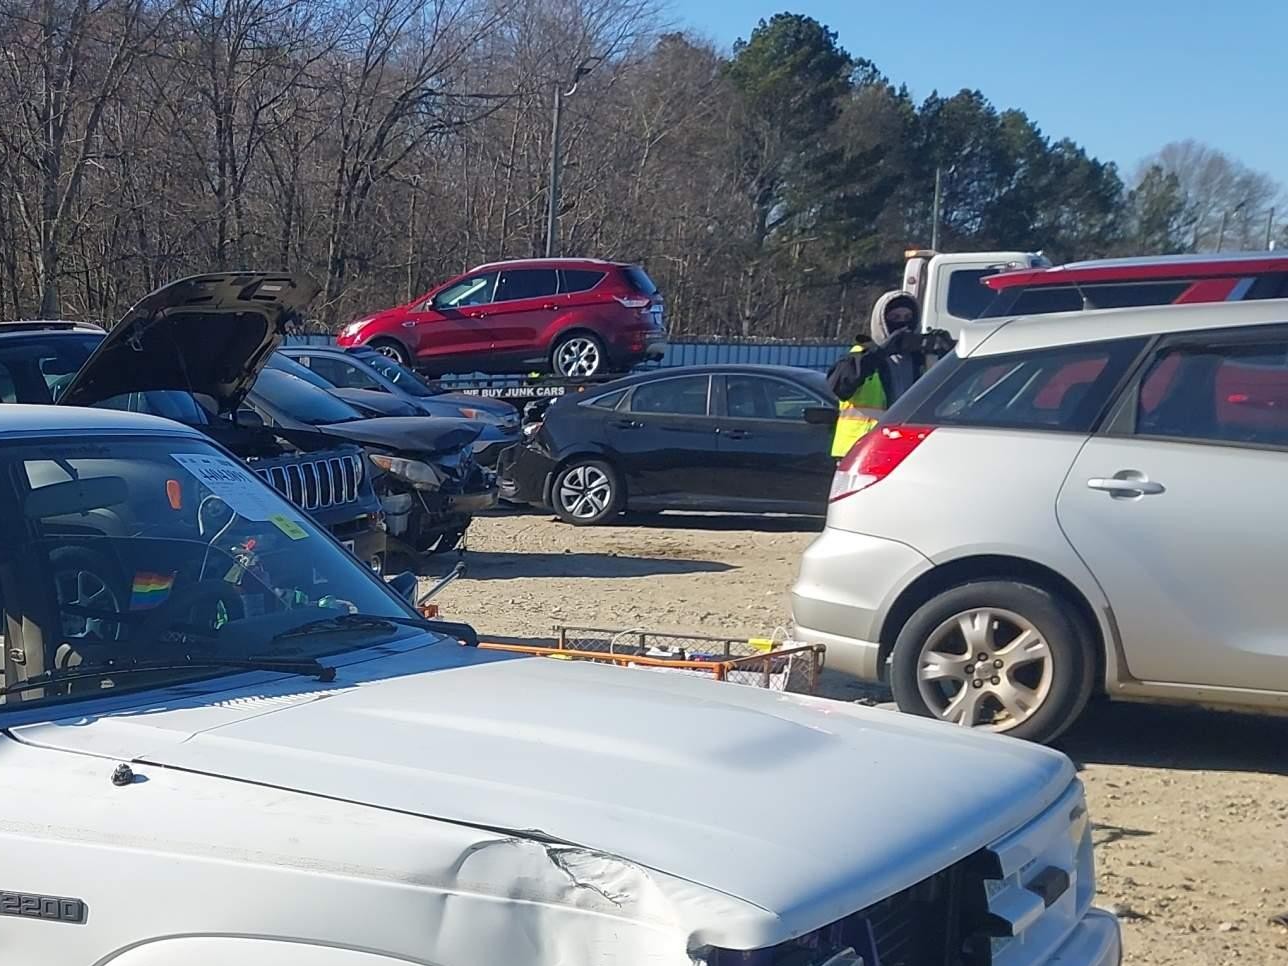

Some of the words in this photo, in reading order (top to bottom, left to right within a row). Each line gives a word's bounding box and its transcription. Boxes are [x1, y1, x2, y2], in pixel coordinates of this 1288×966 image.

[481, 388, 504, 398] BUY
[505, 387, 534, 397] JUNK
[536, 386, 566, 396] CARS
